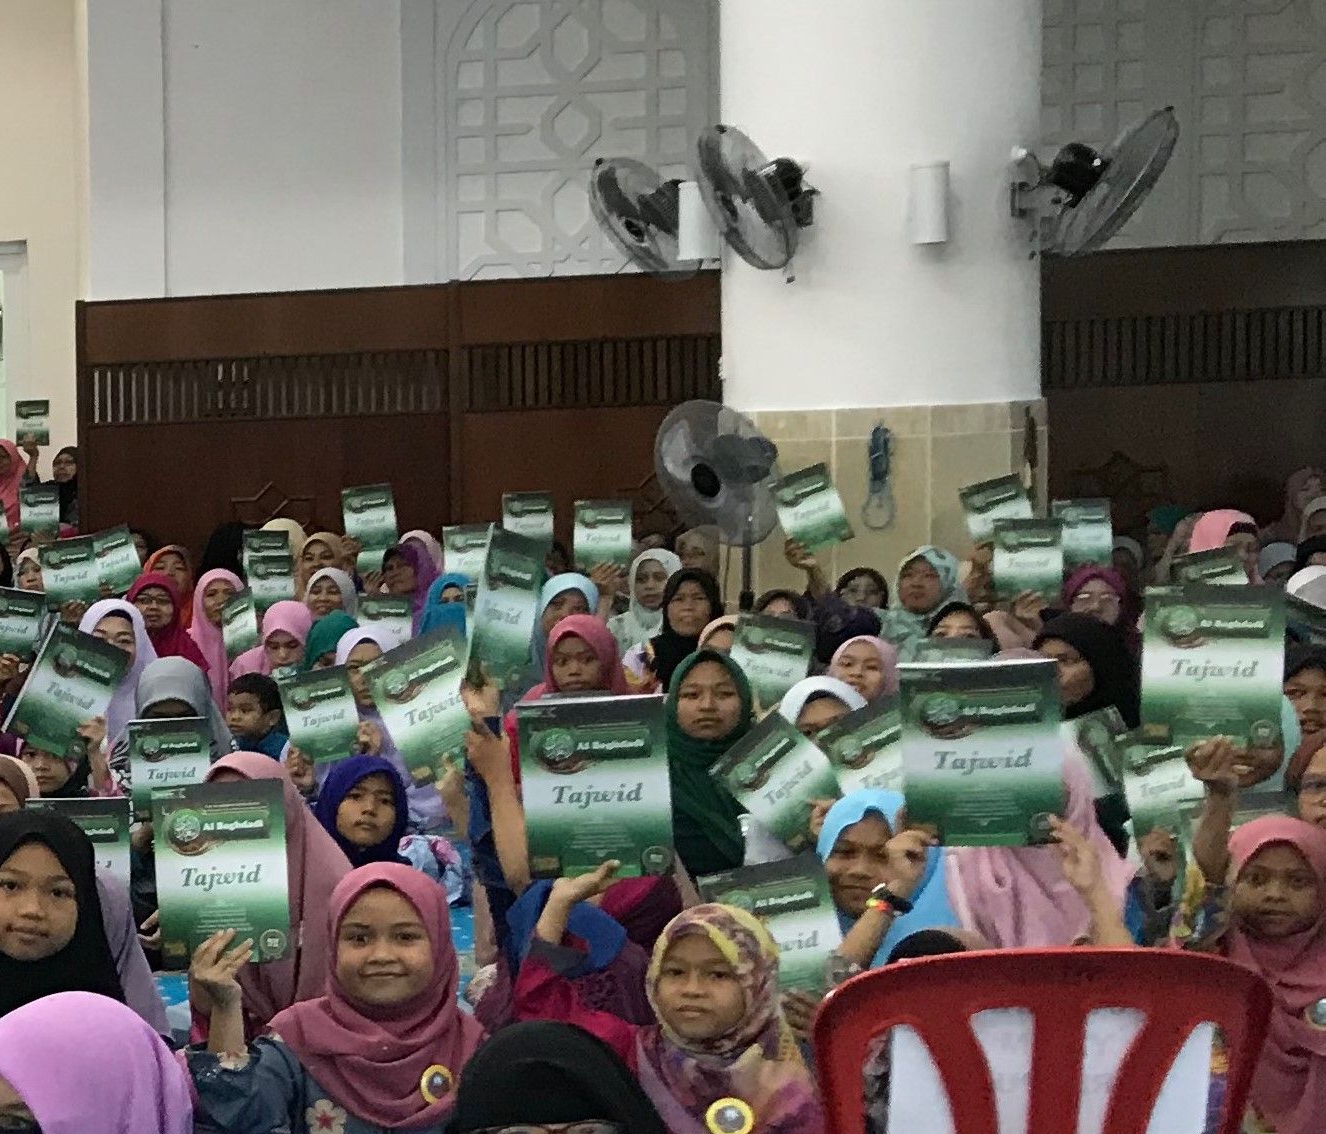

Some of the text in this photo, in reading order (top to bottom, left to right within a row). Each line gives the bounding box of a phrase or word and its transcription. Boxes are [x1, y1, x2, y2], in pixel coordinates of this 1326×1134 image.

[1171, 659, 1260, 680] Tajwid
[47, 682, 95, 710] Tajwid
[302, 711, 344, 728] Tajwid
[404, 692, 460, 726] Tajwi
[147, 767, 196, 781] Tajwid
[934, 748, 1032, 776] Tajwid
[552, 784, 643, 808] Tajwid
[204, 819, 263, 831] Al Baghdadi
[181, 864, 262, 889] Tajwid
